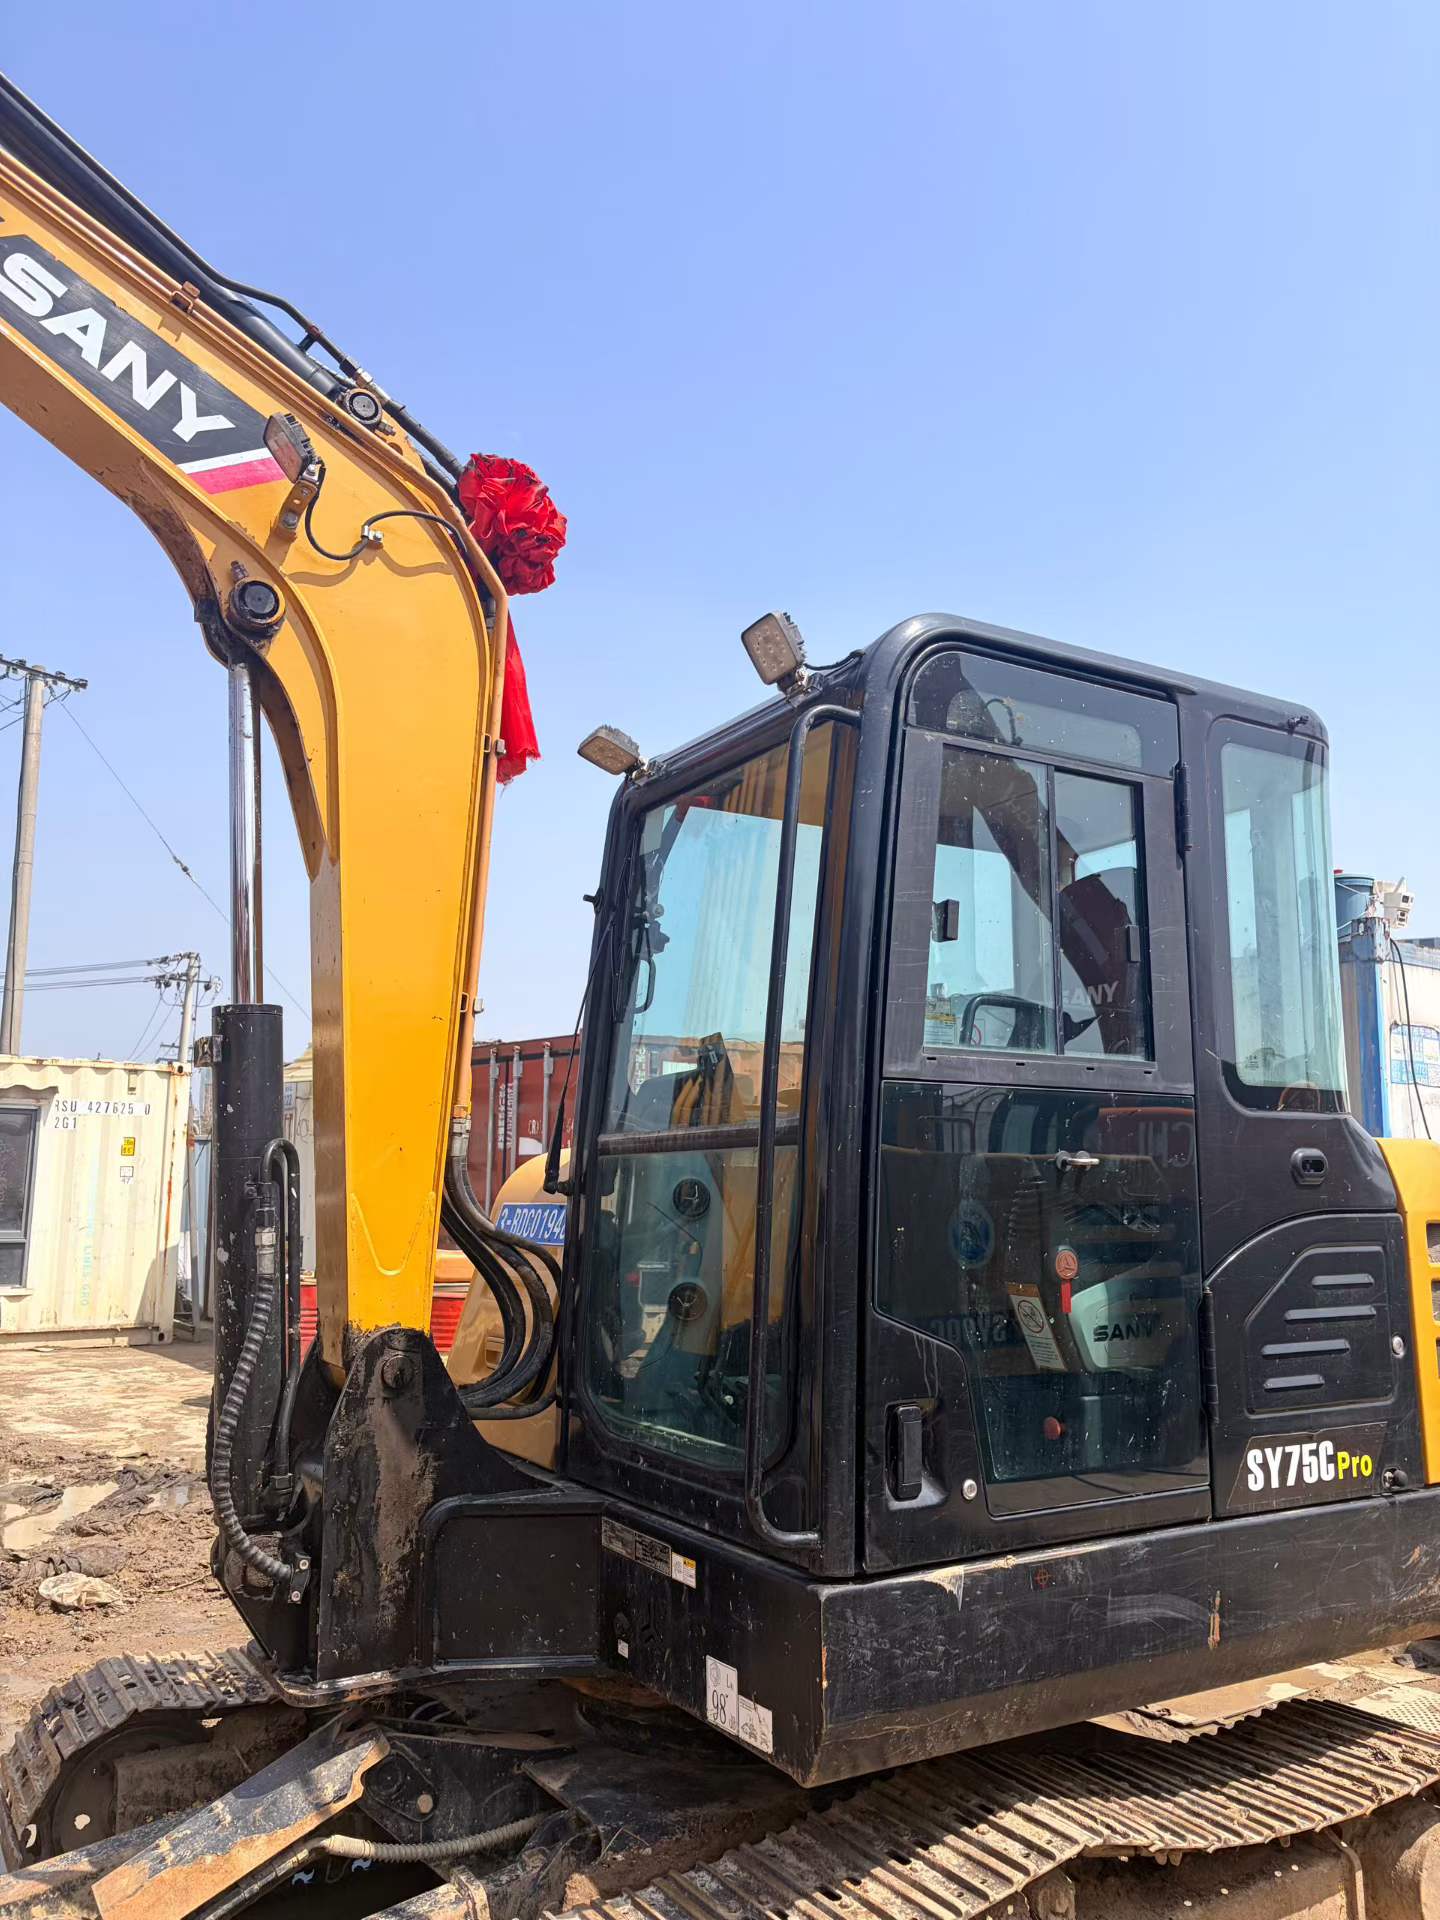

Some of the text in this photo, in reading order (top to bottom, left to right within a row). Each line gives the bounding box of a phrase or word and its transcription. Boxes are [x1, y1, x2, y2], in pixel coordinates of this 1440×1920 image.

[0, 252, 236, 443] SANY
[87, 1101, 134, 1115] 427625
[1246, 1440, 1373, 1492] SY75C Pro
